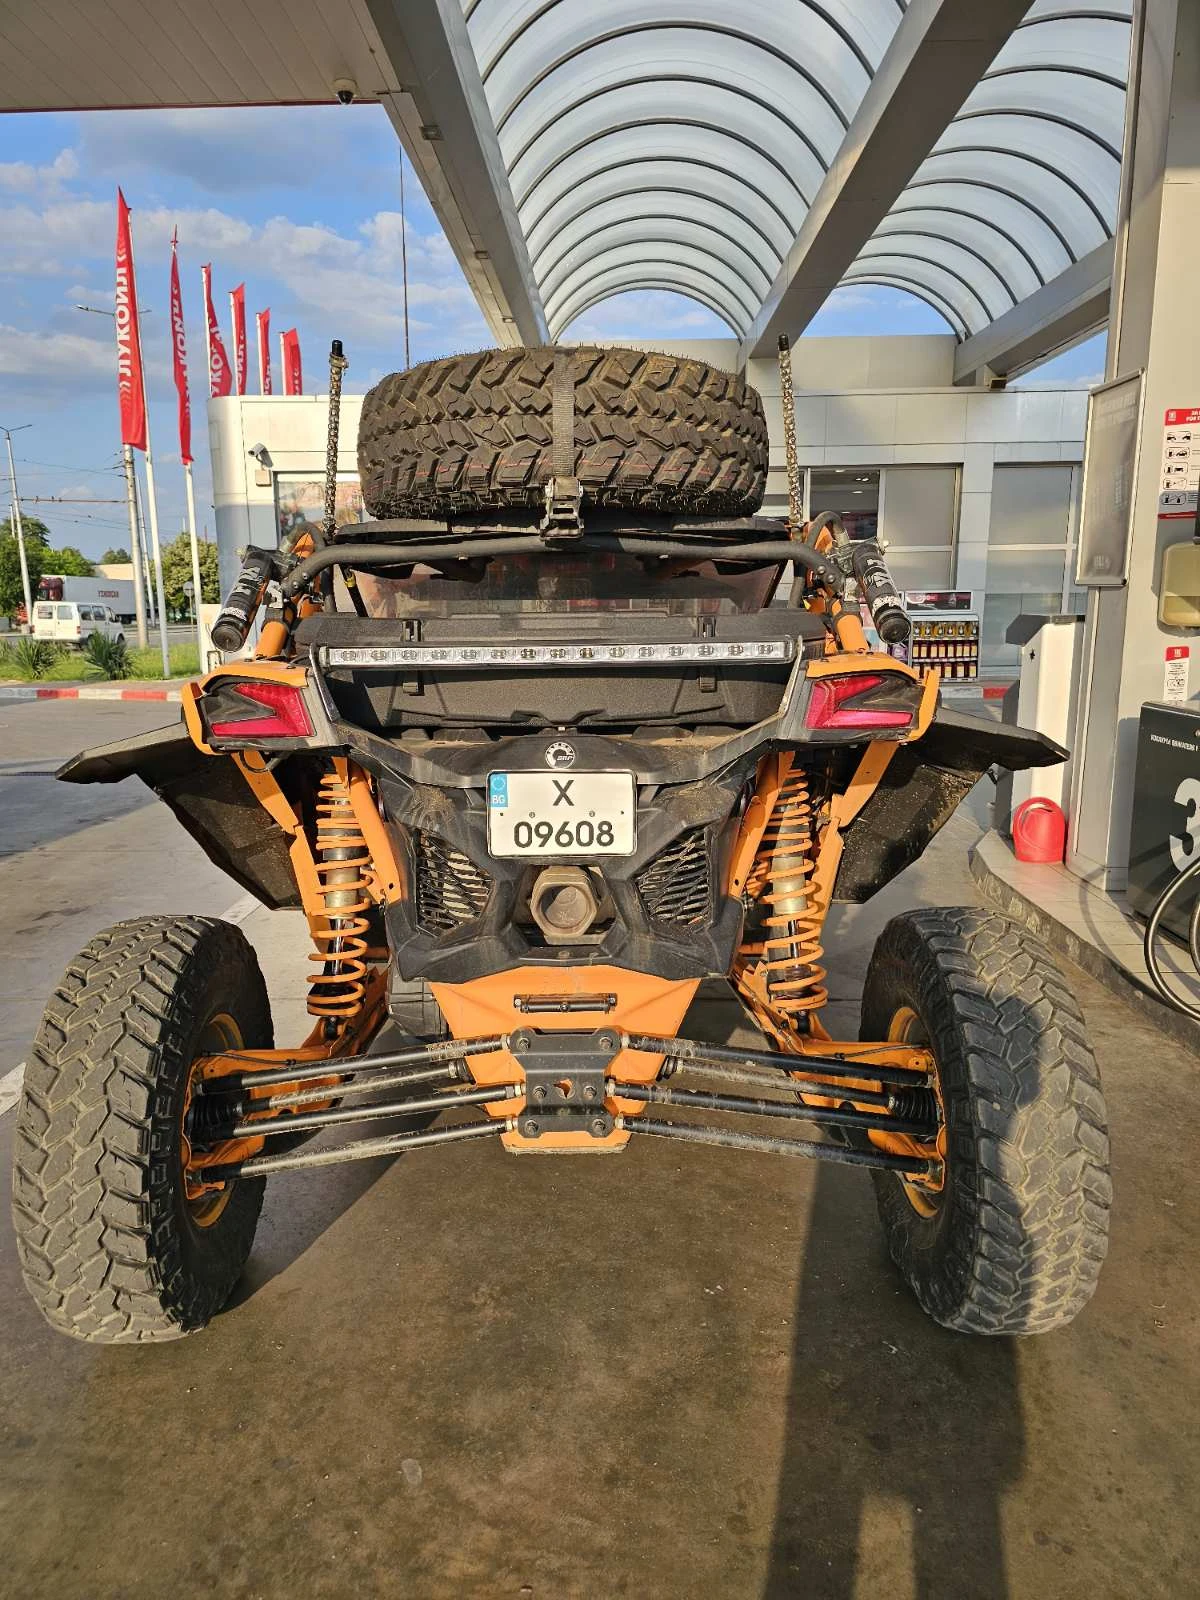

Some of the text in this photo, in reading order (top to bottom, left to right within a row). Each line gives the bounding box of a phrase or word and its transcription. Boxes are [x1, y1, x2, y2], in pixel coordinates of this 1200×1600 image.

[492, 794, 505, 804] BG
[552, 779, 575, 807] X
[513, 820, 615, 849] 09608
